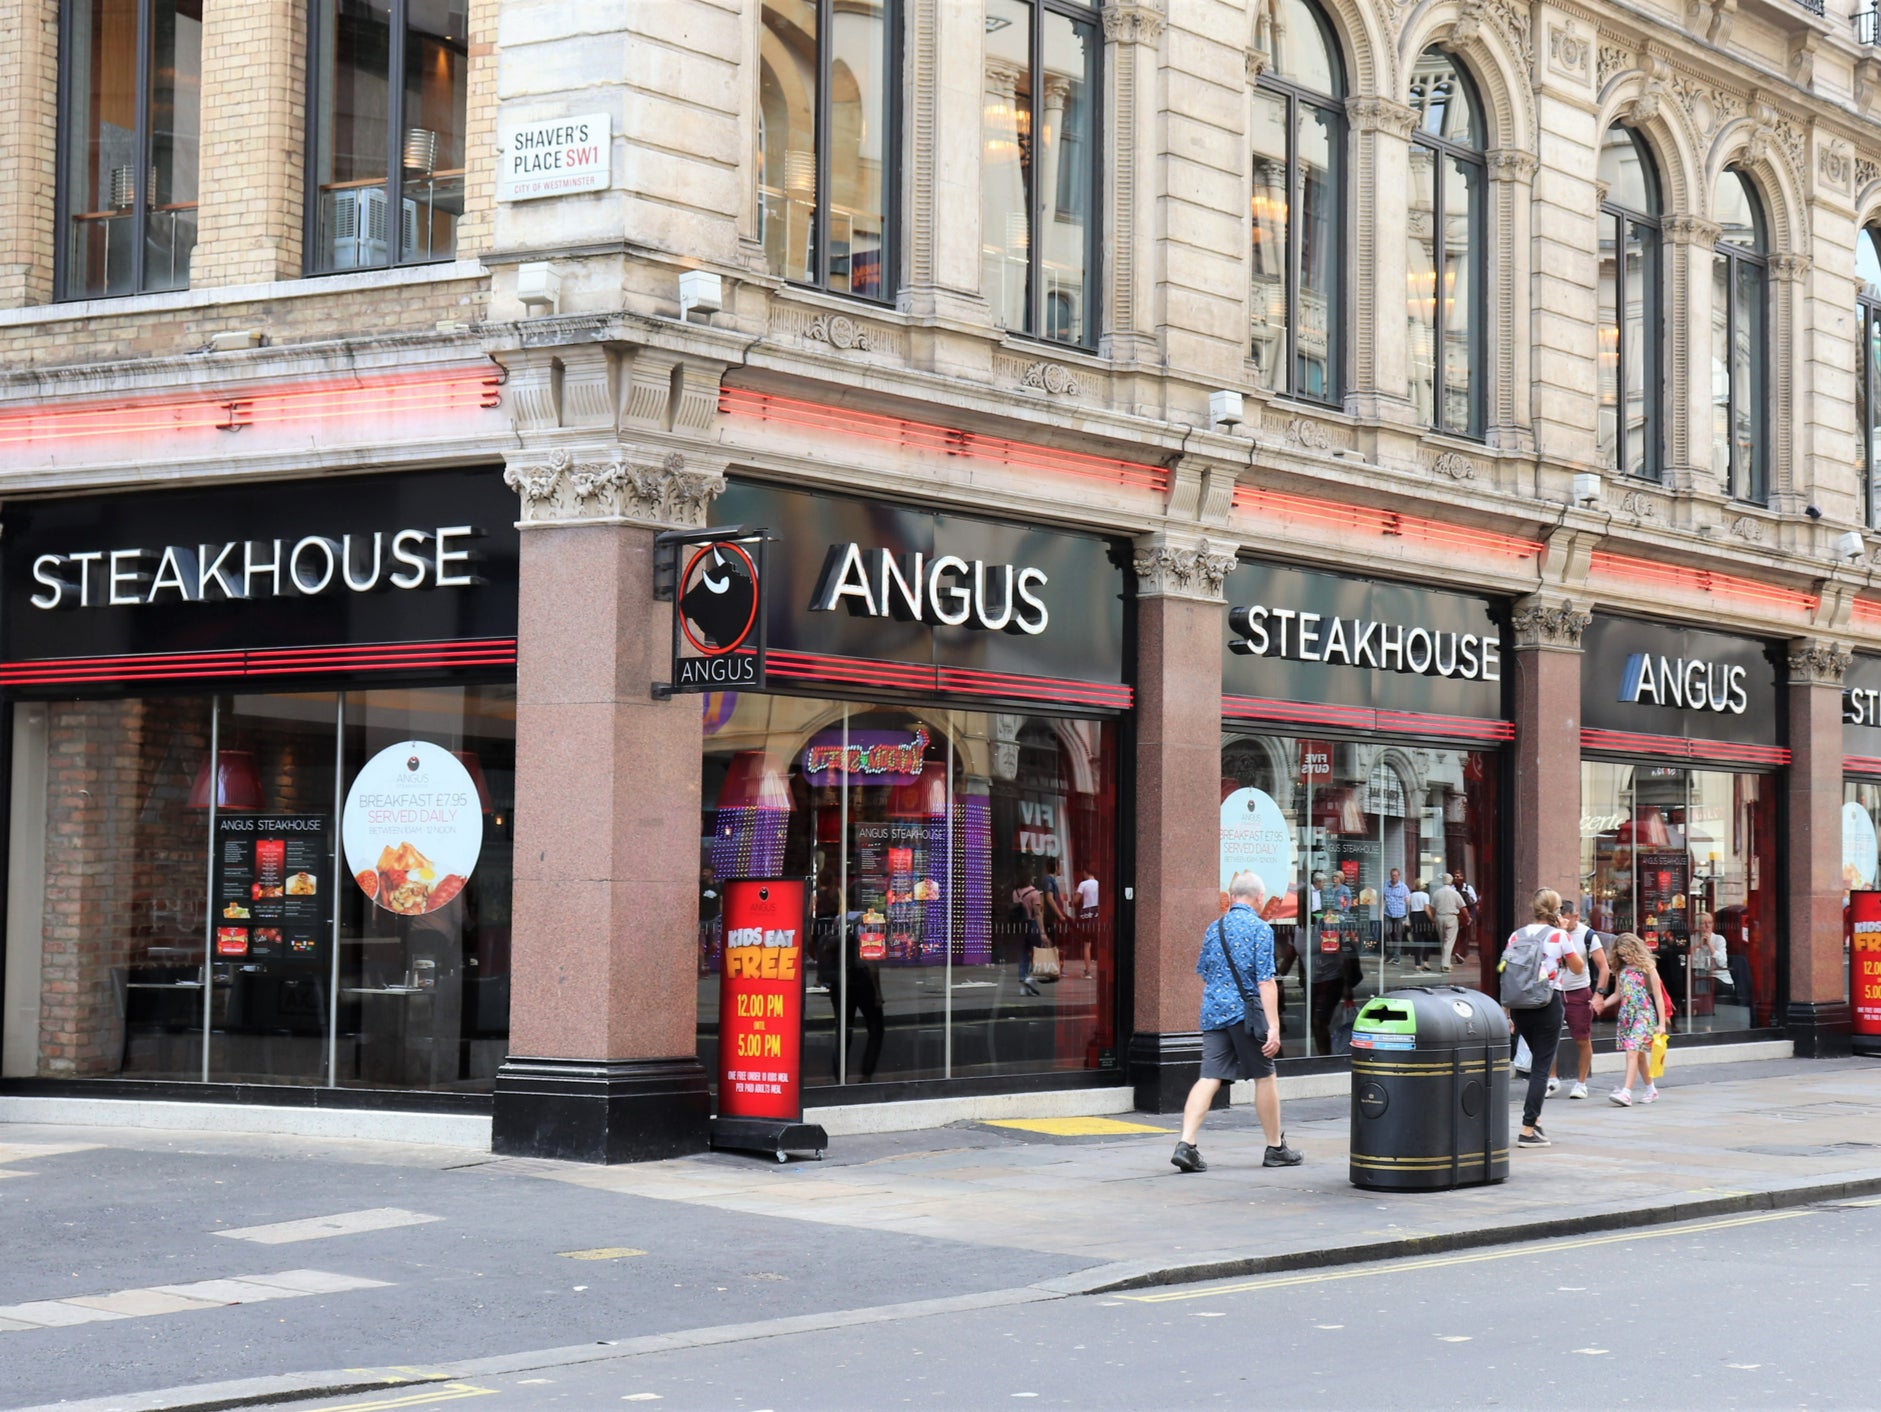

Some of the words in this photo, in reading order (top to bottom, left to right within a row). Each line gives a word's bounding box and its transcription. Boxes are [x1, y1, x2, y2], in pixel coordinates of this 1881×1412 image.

[515, 124, 588, 151] SHAVER'S
[514, 150, 562, 174] PLACE
[566, 146, 598, 167] SW1
[514, 184, 530, 194] CITY
[532, 183, 541, 192] OF
[543, 176, 595, 190] WESTMINSTER
[30, 525, 473, 610] STEAKHOUSE
[826, 542, 1049, 635] ANGUS
[1246, 604, 1500, 681] STEAKHOUSE
[680, 657, 754, 682] ANGUS
[1634, 652, 1748, 715] ANGUS
[1850, 686, 1881, 725] ST
[396, 773, 430, 784] ANGUS
[359, 794, 433, 808] BREAKFAST
[220, 820, 254, 831] ANGUS
[257, 820, 321, 831] STEAKHOUSE
[367, 809, 418, 824] SERVED
[419, 809, 457, 823] DAILY
[368, 827, 402, 836] BETWEEN
[859, 828, 888, 839] ANGUS
[891, 828, 945, 840] STEAKHOUSE
[1224, 842, 1254, 854] SERVED
[1342, 844, 1381, 855] STEAKHOUSE
[728, 927, 763, 948] KIDS
[764, 929, 796, 948] EAT
[725, 946, 799, 981] FREE
[1864, 961, 1881, 975] 12.0
[737, 994, 764, 1018] 12.00
[767, 995, 784, 1019] PM
[753, 1020, 766, 1031] UNTIL
[738, 1034, 761, 1057] 5.00
[764, 1034, 781, 1058] PM
[736, 1071, 747, 1081] FREE
